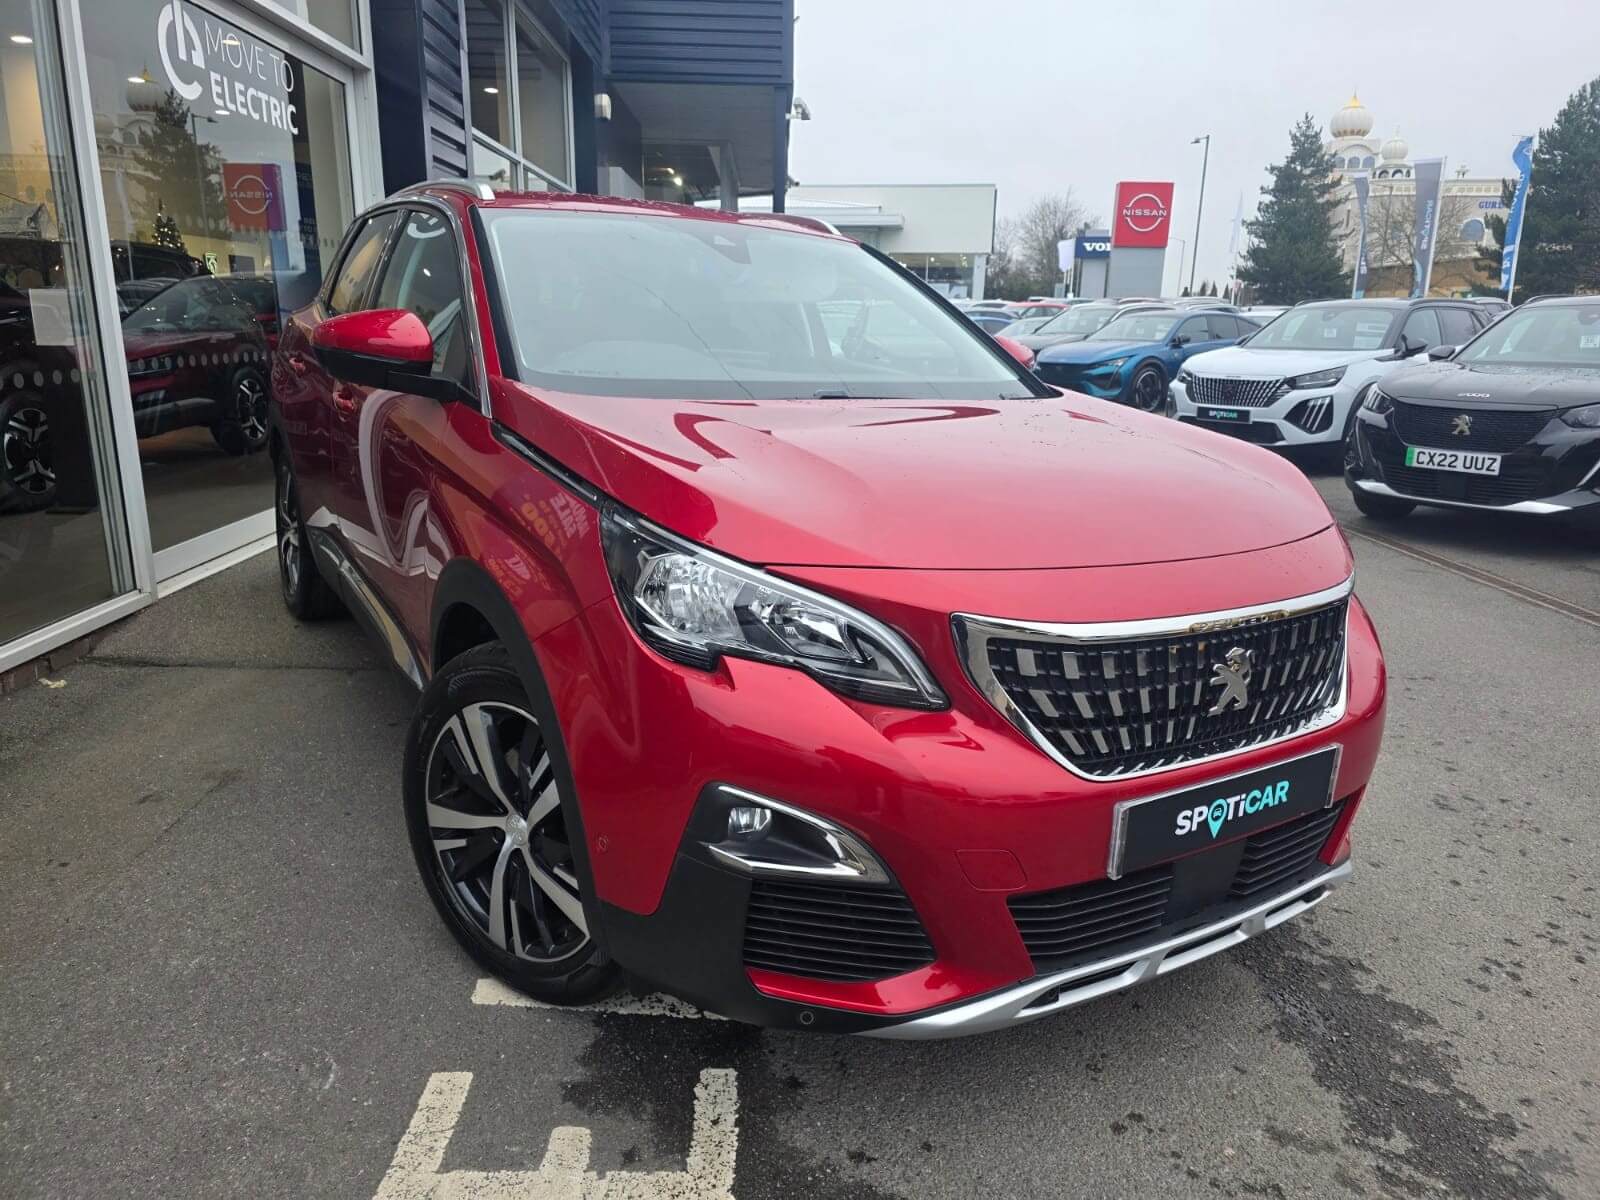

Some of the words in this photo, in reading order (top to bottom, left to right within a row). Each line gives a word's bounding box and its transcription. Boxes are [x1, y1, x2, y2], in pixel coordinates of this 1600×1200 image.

[204, 20, 267, 81] MOVE
[269, 53, 294, 92] TO
[210, 70, 299, 135] ELECTRIC
[1122, 208, 1167, 216] NISSAN
[1416, 450, 1458, 469] CX22
[1462, 457, 1498, 474] UUZ
